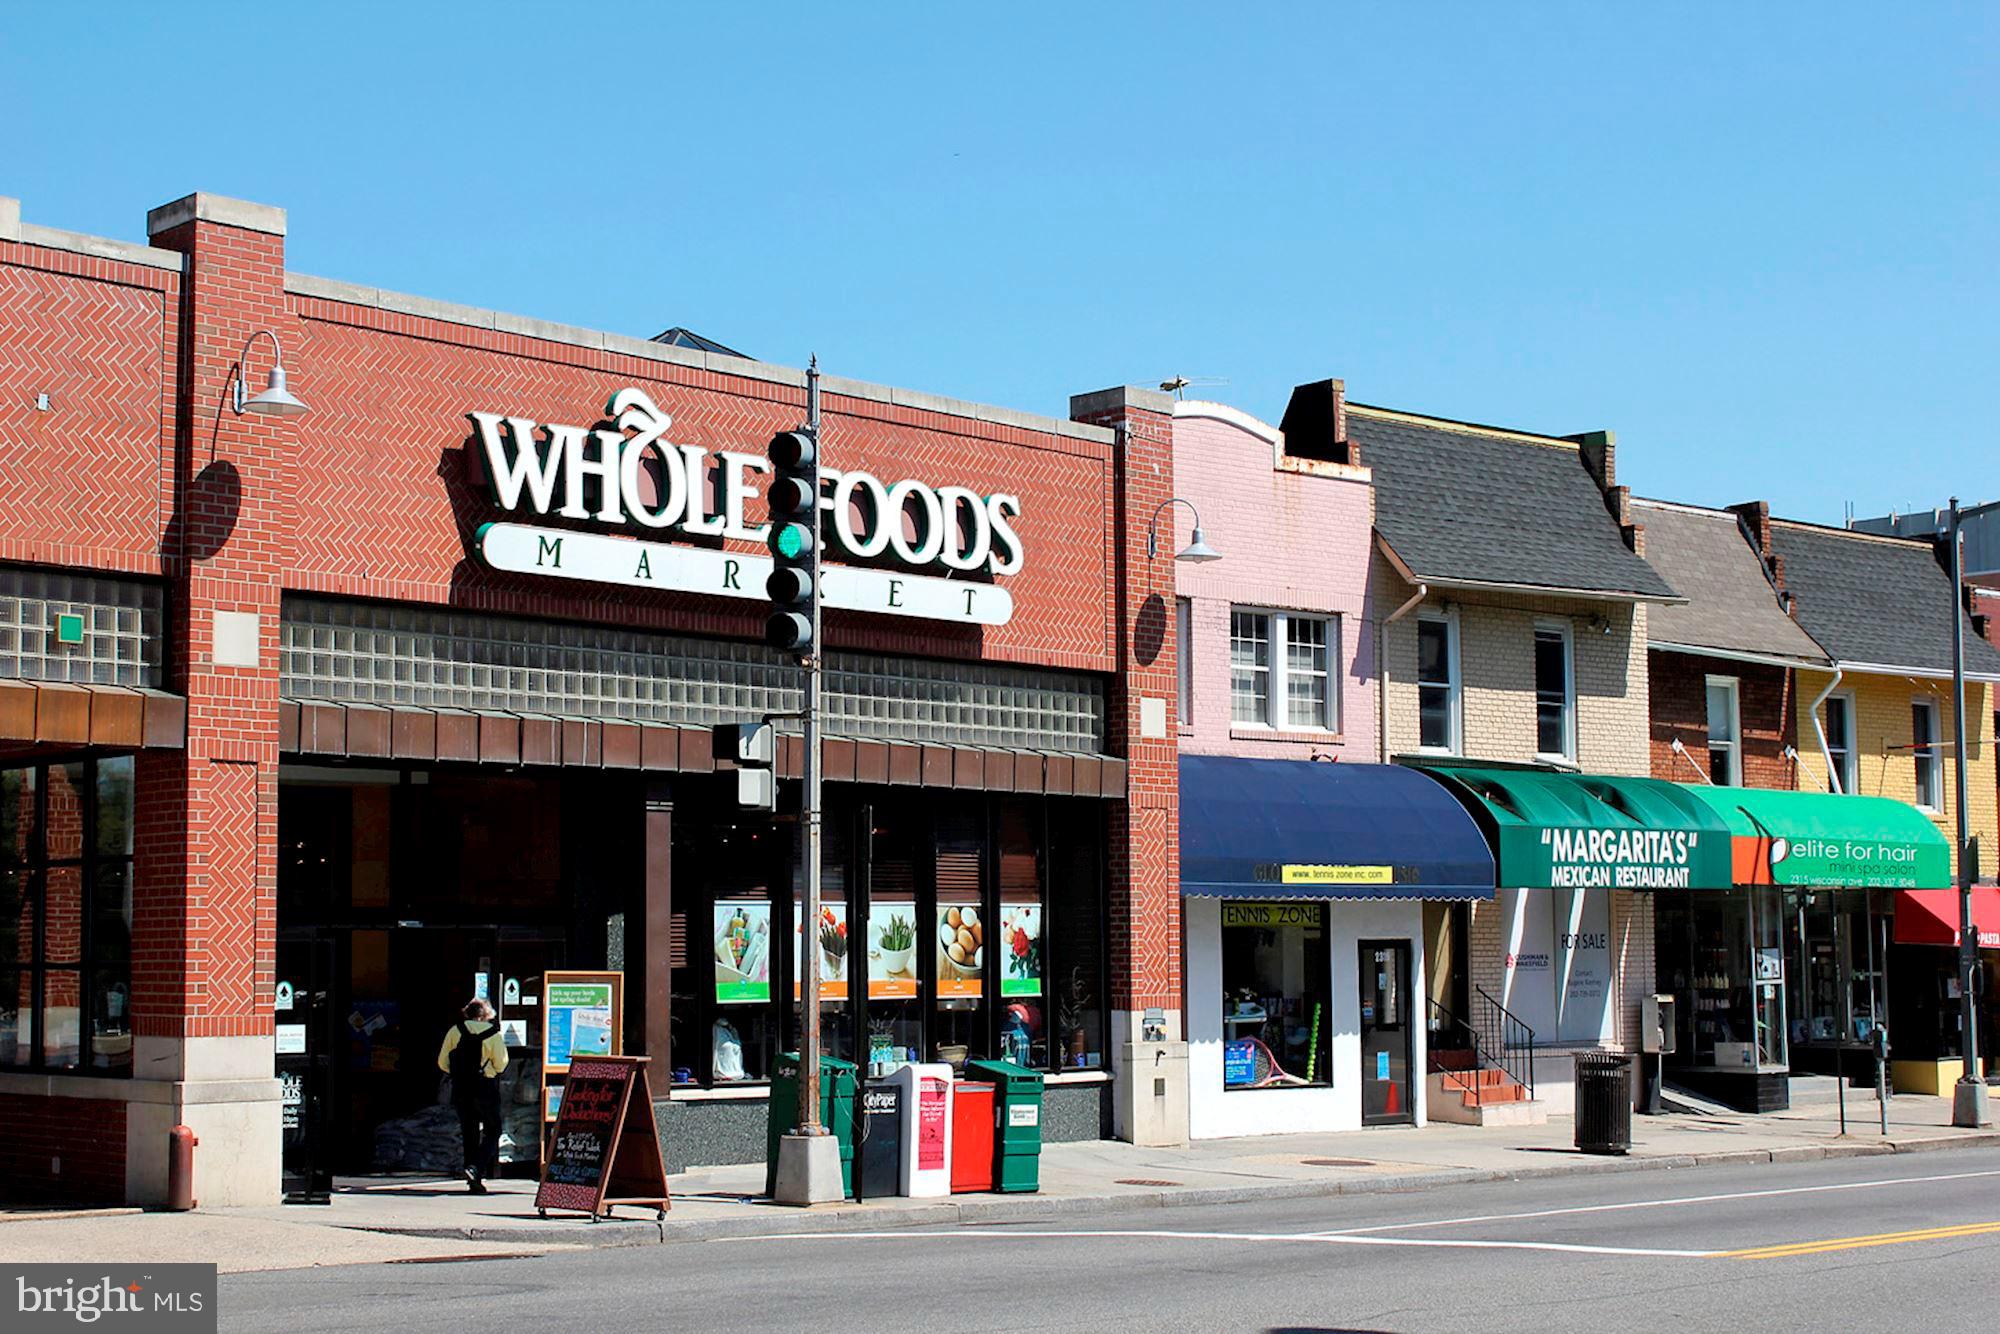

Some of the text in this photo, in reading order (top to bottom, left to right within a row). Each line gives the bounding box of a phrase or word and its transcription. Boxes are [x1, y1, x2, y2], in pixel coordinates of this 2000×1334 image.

[471, 389, 771, 541] WHOLE
[537, 535, 977, 616] MARET
[1792, 840, 1918, 862] elite for hair
[1551, 866, 1690, 888] MEXICAN RESTAURANT
[1829, 862, 1916, 876] mini spa salon
[1278, 906, 1320, 923] ZONE
[1561, 934, 1606, 949] FOR SALE
